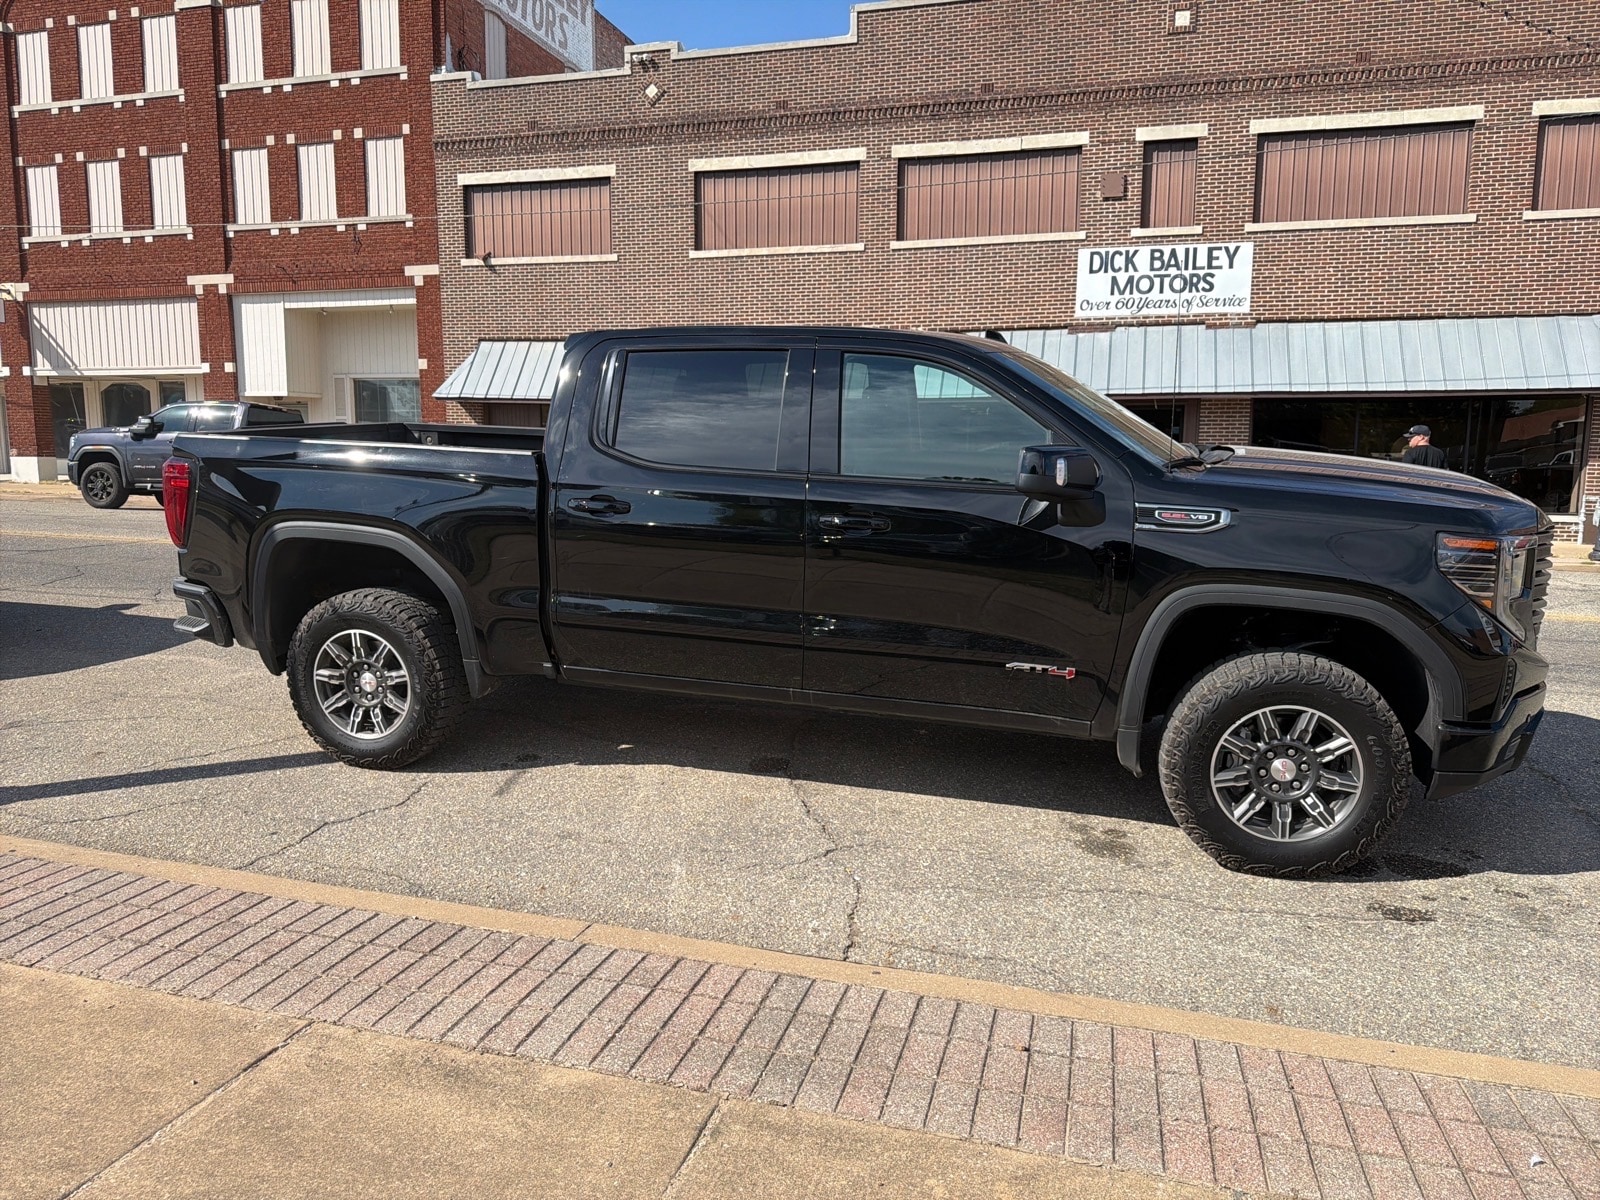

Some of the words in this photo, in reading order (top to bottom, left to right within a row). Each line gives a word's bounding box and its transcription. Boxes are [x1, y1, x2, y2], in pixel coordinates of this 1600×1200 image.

[1089, 249, 1140, 274] DICK
[1149, 245, 1242, 272] BAILEY
[1110, 272, 1216, 296] MOTORS
[1079, 298, 1111, 312] Over
[1114, 297, 1134, 311] 60
[1131, 296, 1178, 315] Years
[1181, 295, 1197, 313] of
[1197, 294, 1248, 309] Service
[1005, 661, 1076, 680] AT4
